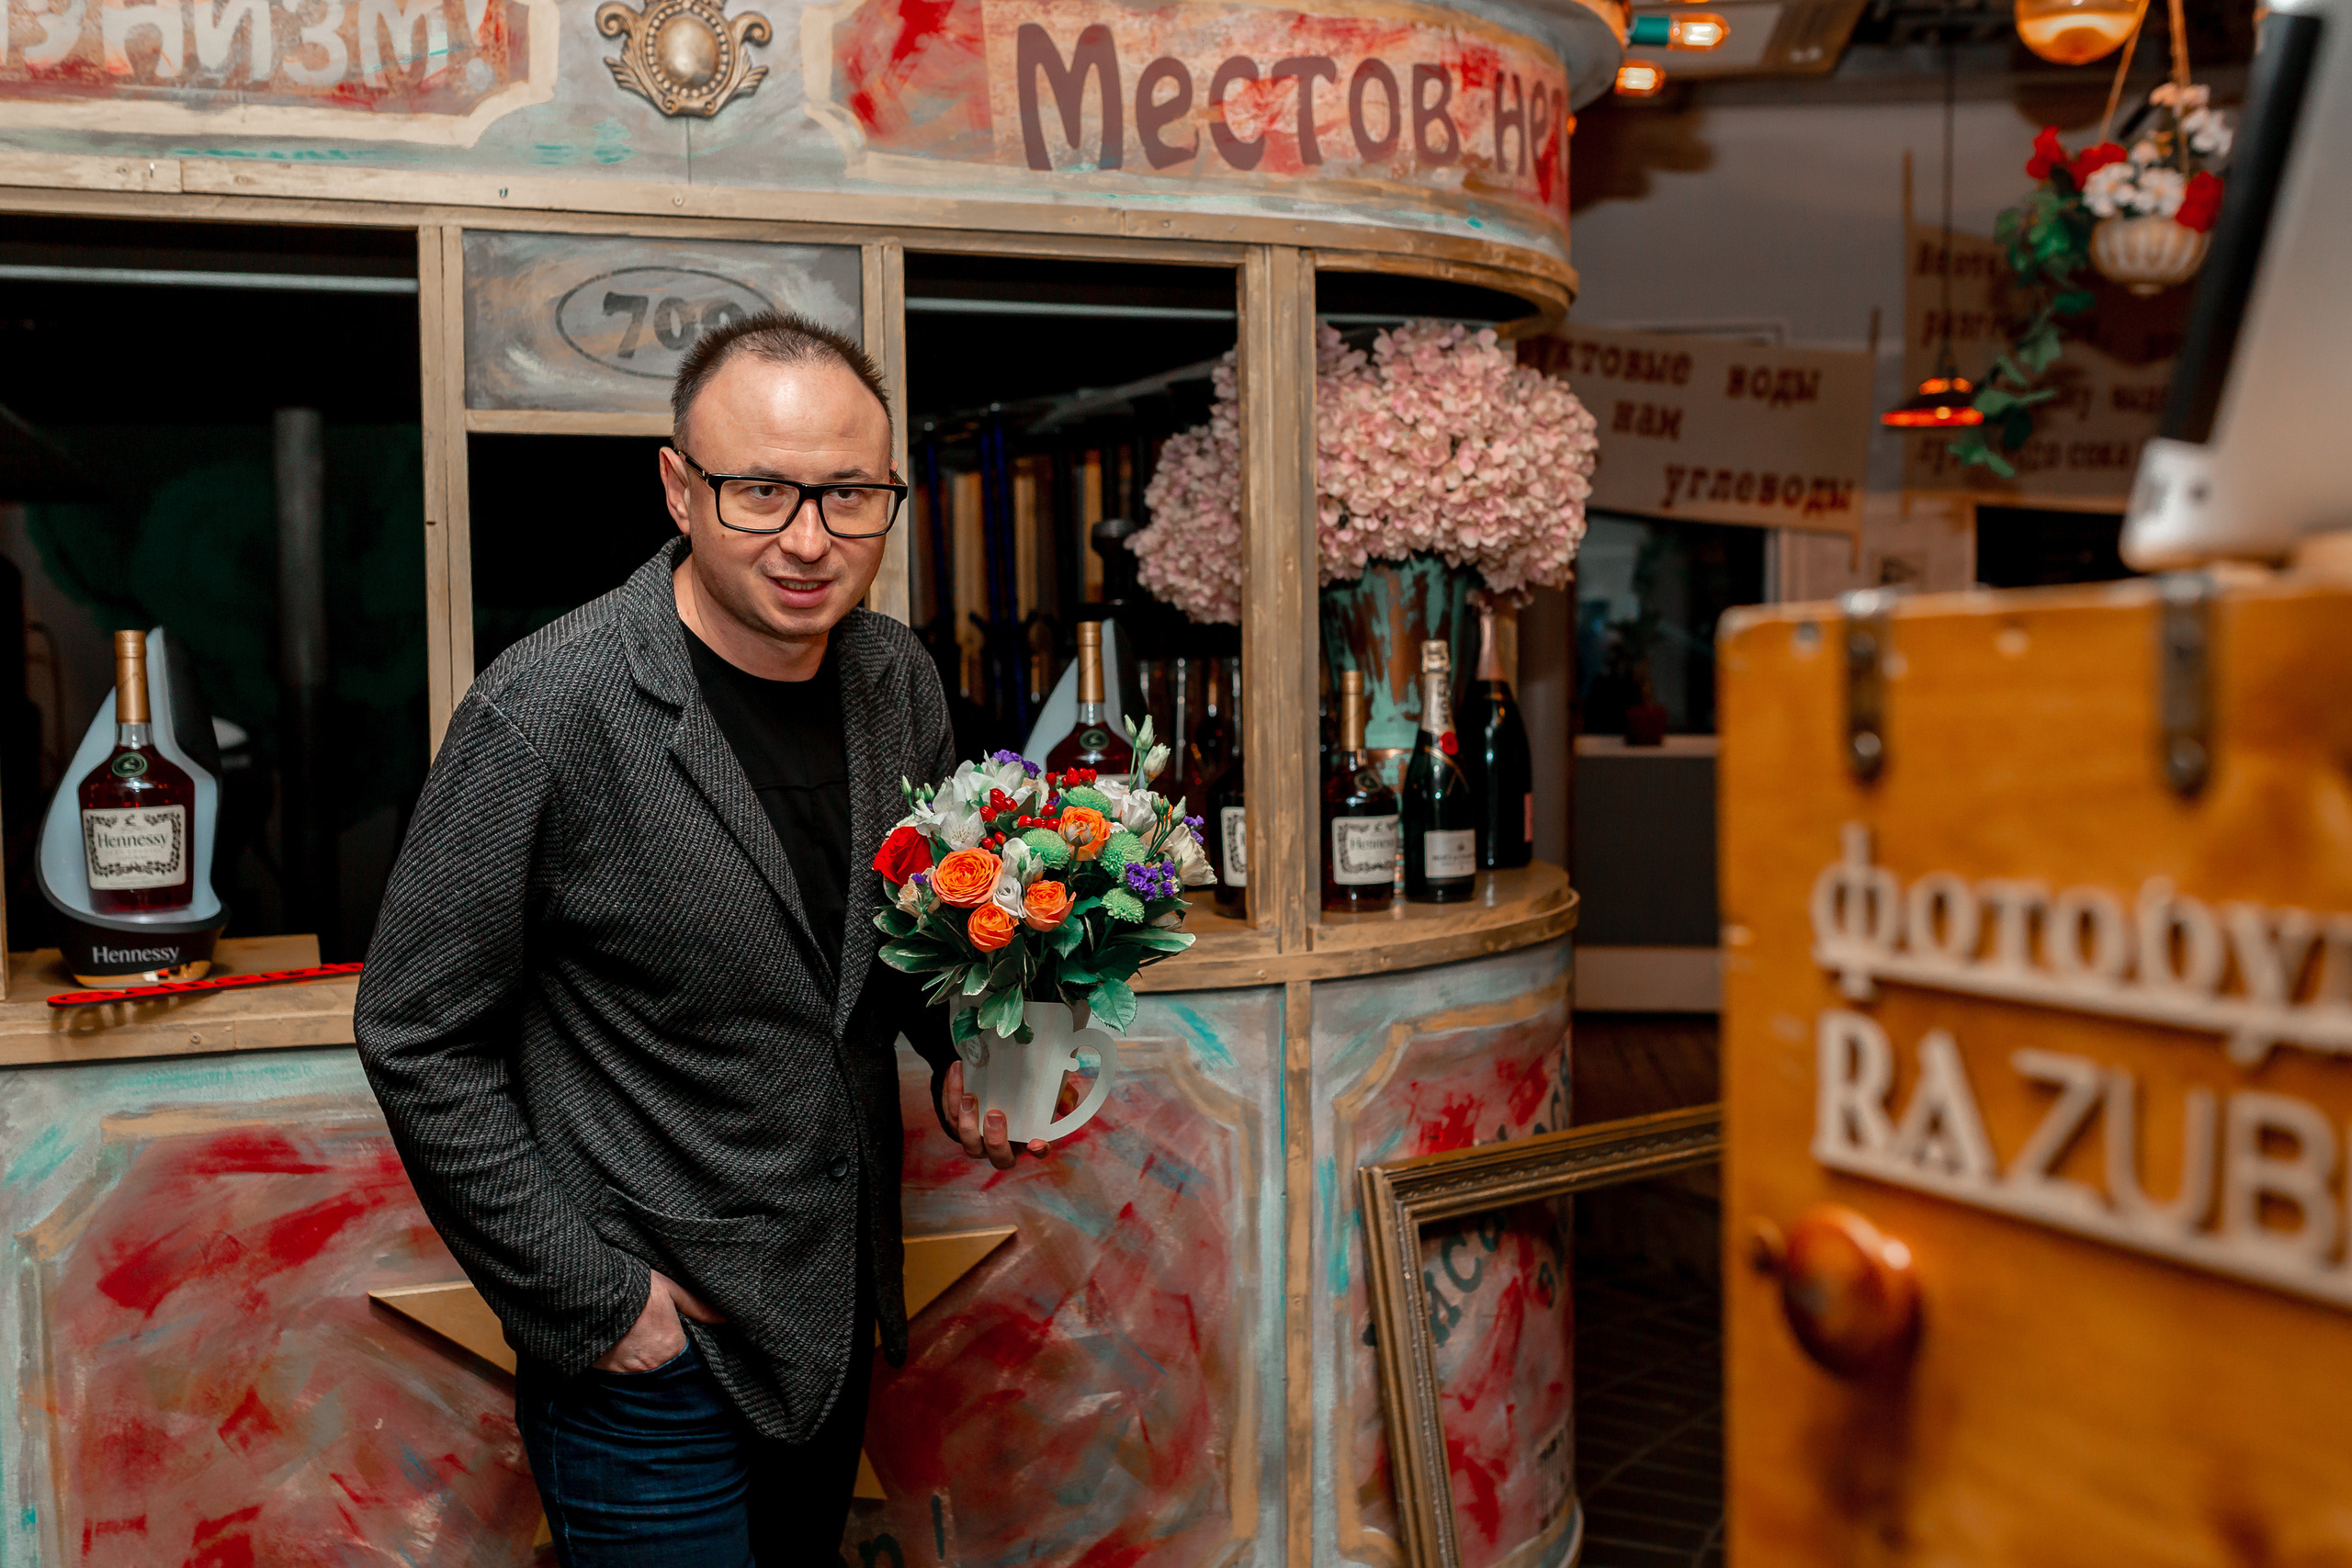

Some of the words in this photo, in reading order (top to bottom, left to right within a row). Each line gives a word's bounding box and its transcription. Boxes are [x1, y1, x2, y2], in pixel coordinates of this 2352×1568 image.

[0, 0, 490, 92] УНИЗМ!
[96, 832, 168, 849] Hennessy
[92, 946, 180, 964] Hennessy
[1811, 1009, 2352, 1281] RAZUB
